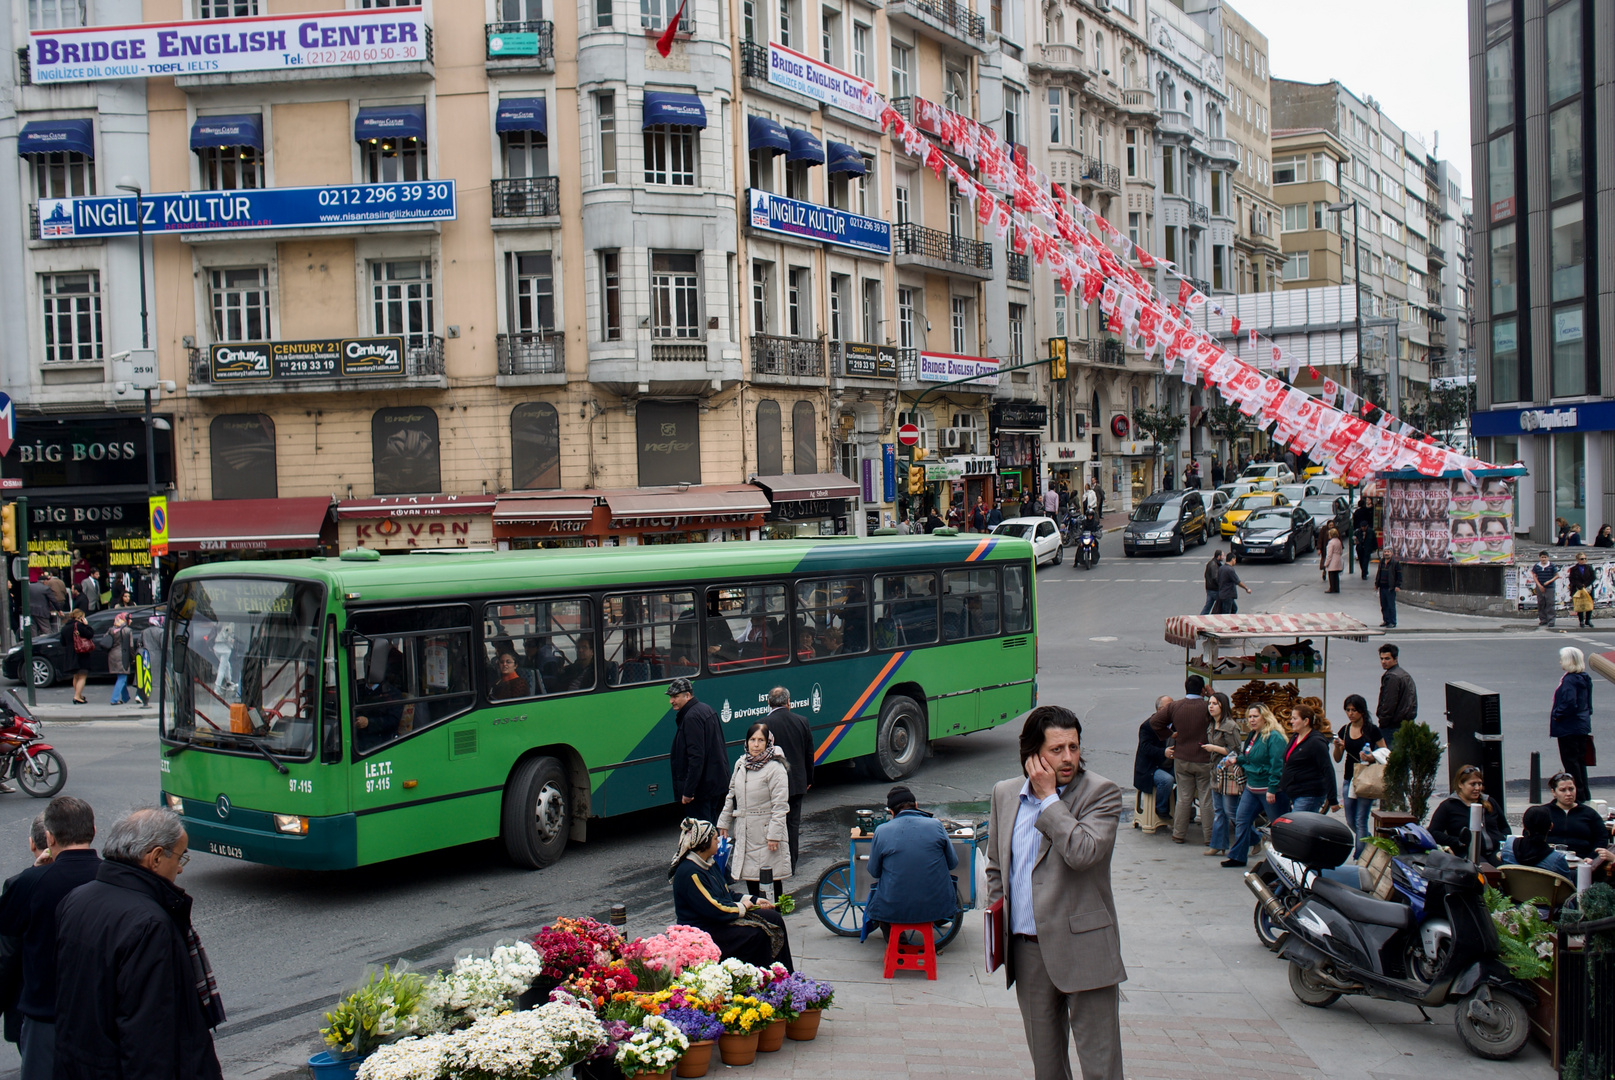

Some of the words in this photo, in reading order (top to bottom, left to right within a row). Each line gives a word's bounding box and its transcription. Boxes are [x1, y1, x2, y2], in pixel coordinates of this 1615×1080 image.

[36, 38, 146, 65] BRIDGE
[157, 30, 286, 57] ENGLISH
[298, 22, 418, 48] CENTER
[283, 53, 303, 65] Tel:
[306, 51, 337, 64] (212)
[340, 50, 360, 62] 240
[363, 49, 378, 60] 60
[380, 48, 394, 59] 50
[403, 46, 417, 58] 30
[37, 66, 84, 80] İNGİLİZCE
[86, 65, 102, 77] DİL
[104, 64, 138, 76] OKULU
[188, 60, 219, 71] IELTS
[772, 50, 803, 78] BRIDGE
[806, 64, 840, 93] ENGLISH
[843, 80, 872, 104] CENTR
[318, 188, 360, 206] 0212
[365, 187, 396, 204] 296
[401, 186, 422, 201] 39
[426, 184, 448, 200] 30
[78, 198, 156, 228] İNGİLZ
[164, 192, 251, 224] KÜLTÜR
[770, 197, 806, 226] İNGİLİZ
[808, 206, 846, 235] KÜLTÜR
[850, 217, 863, 228] 0212
[864, 219, 873, 230] 296
[880, 224, 888, 234] 30
[274, 344, 326, 354] CENTURY
[328, 342, 340, 352] 21
[346, 342, 389, 358] Century
[385, 350, 398, 364] 21
[216, 348, 259, 363] Century
[254, 356, 268, 370] 21
[290, 362, 308, 371] 219
[310, 360, 320, 370] 33
[324, 360, 334, 370] 19
[854, 360, 862, 368] 219
[863, 361, 868, 369] 33
[922, 358, 946, 374] BRIDGE
[948, 360, 974, 376] ENGLISH
[394, 415, 424, 423] nefer
[19, 440, 62, 462] BİG
[72, 442, 136, 462] BOSS
[645, 440, 694, 454] nefer
[965, 457, 992, 474] DÖVİZ
[1404, 490, 1422, 498] PRESS
[1424, 490, 1448, 498] PRESS
[33, 506, 67, 523] BİG
[74, 506, 124, 522] BOSS
[778, 502, 794, 518] Ag
[798, 500, 830, 516] Silver
[356, 518, 468, 538] KOVAN
[548, 520, 587, 532] Aktar
[1404, 530, 1422, 538] PRESS
[1424, 530, 1448, 538] PRESS
[200, 540, 227, 550] STAR
[758, 694, 770, 702] İST
[210, 842, 218, 854] 34
